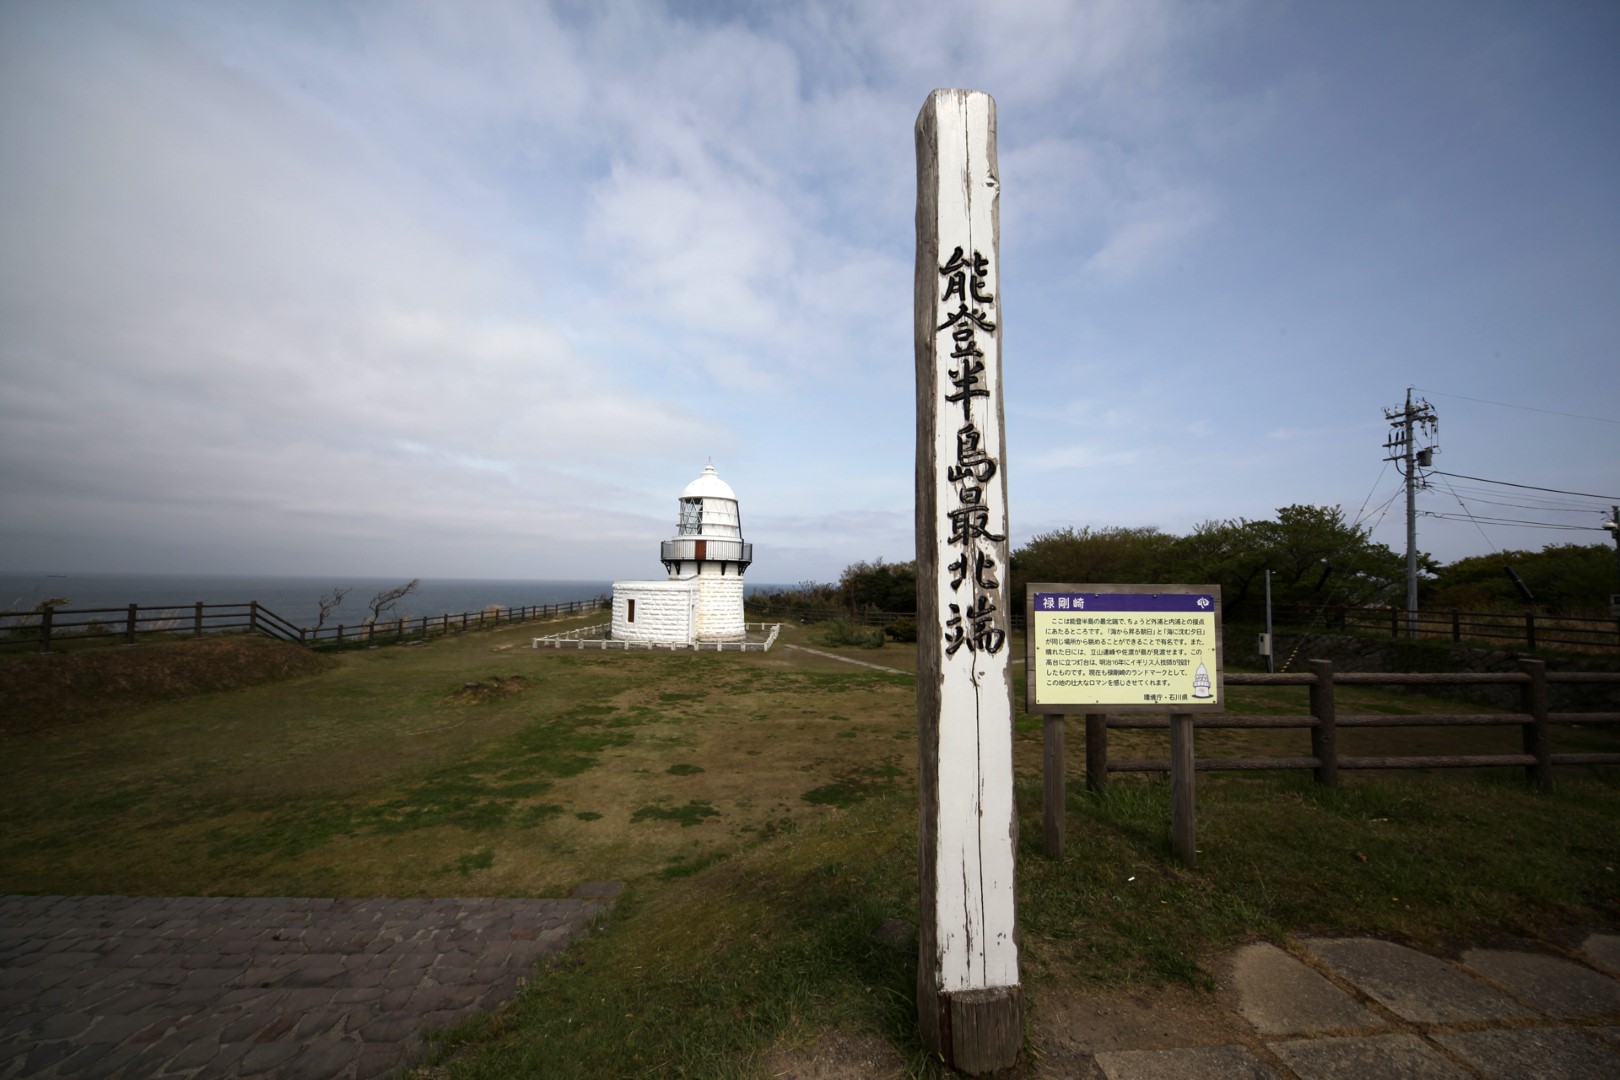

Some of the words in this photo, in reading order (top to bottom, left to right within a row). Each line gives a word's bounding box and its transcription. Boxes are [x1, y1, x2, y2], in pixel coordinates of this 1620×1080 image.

[937, 246, 1006, 654] 能登半島最北端
[1043, 597, 1085, 609] 禄剛崎
